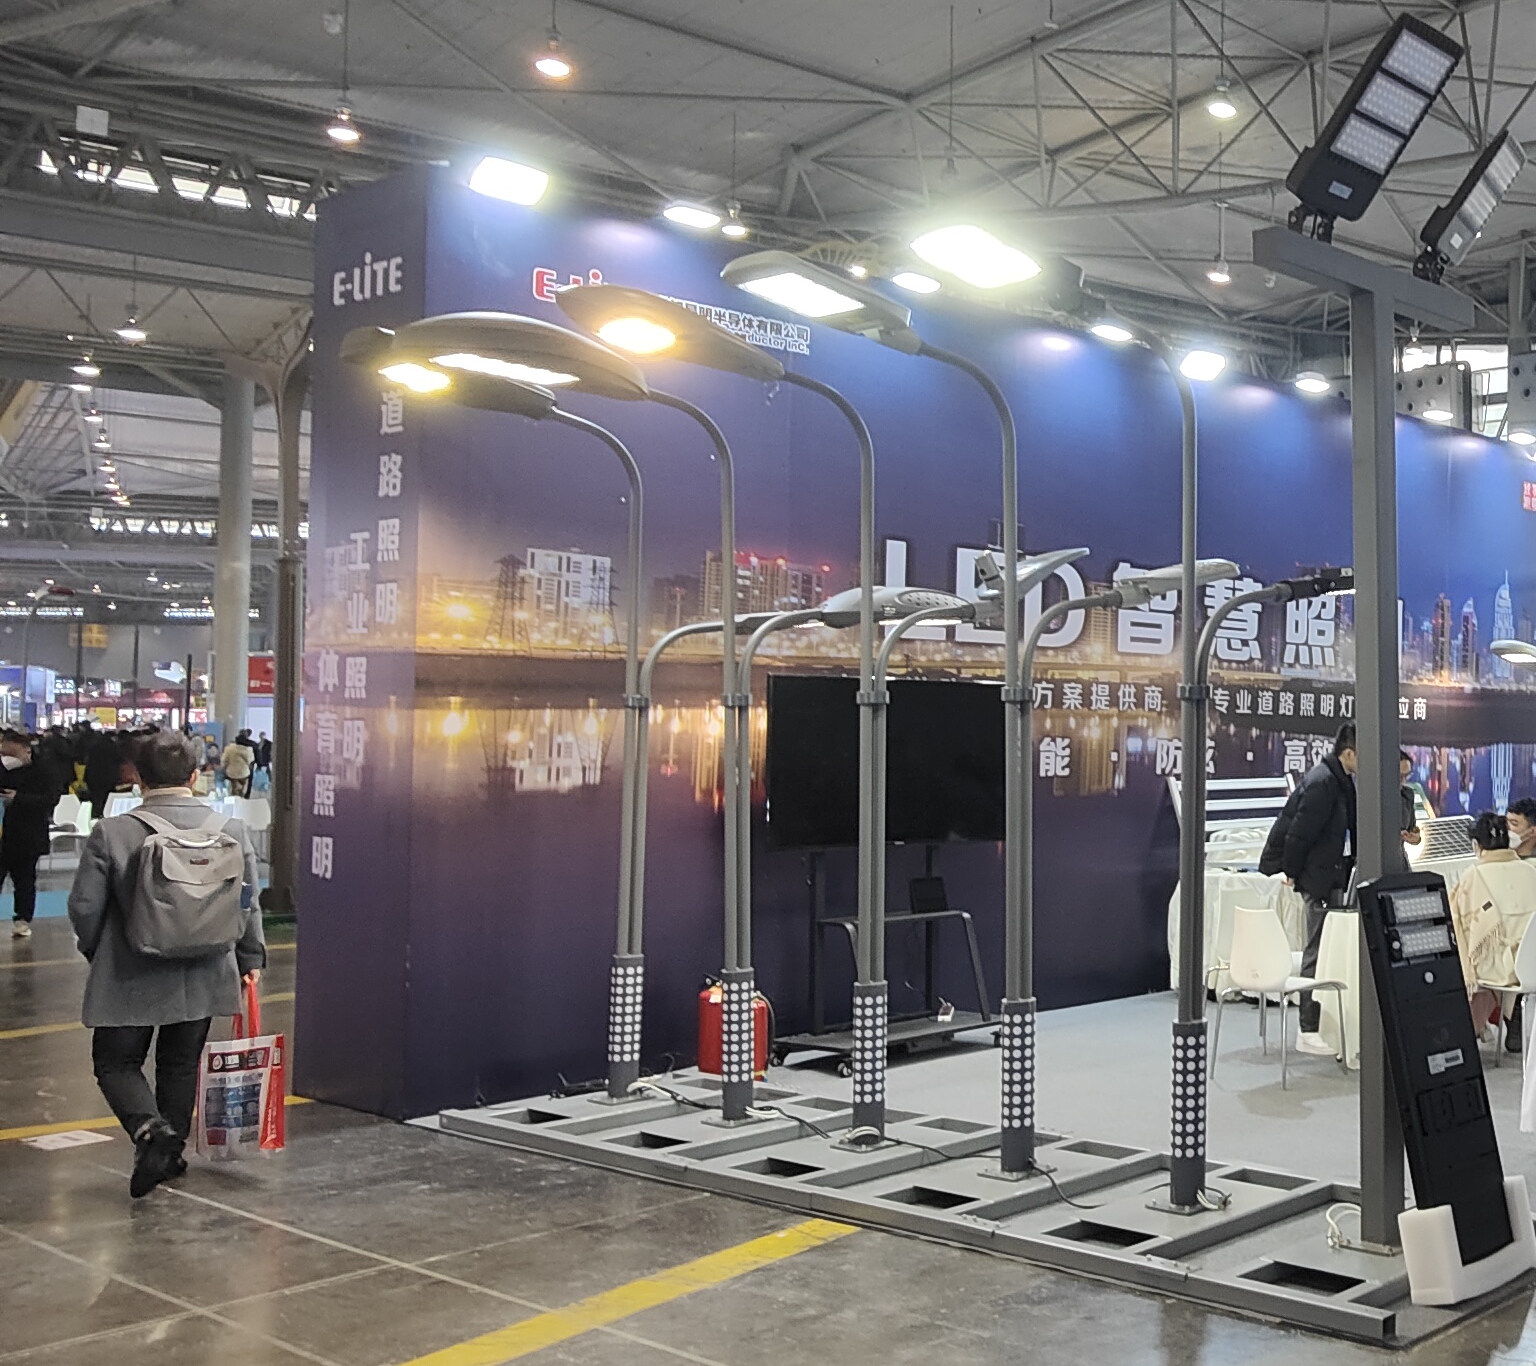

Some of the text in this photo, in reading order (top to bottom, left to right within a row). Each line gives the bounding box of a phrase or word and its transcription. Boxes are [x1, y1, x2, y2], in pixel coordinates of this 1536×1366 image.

[375, 389, 404, 625] 道路照明
[885, 539, 1403, 667] LED智慧照
[311, 646, 339, 880] 体育照明
[342, 531, 371, 765] 工业照明
